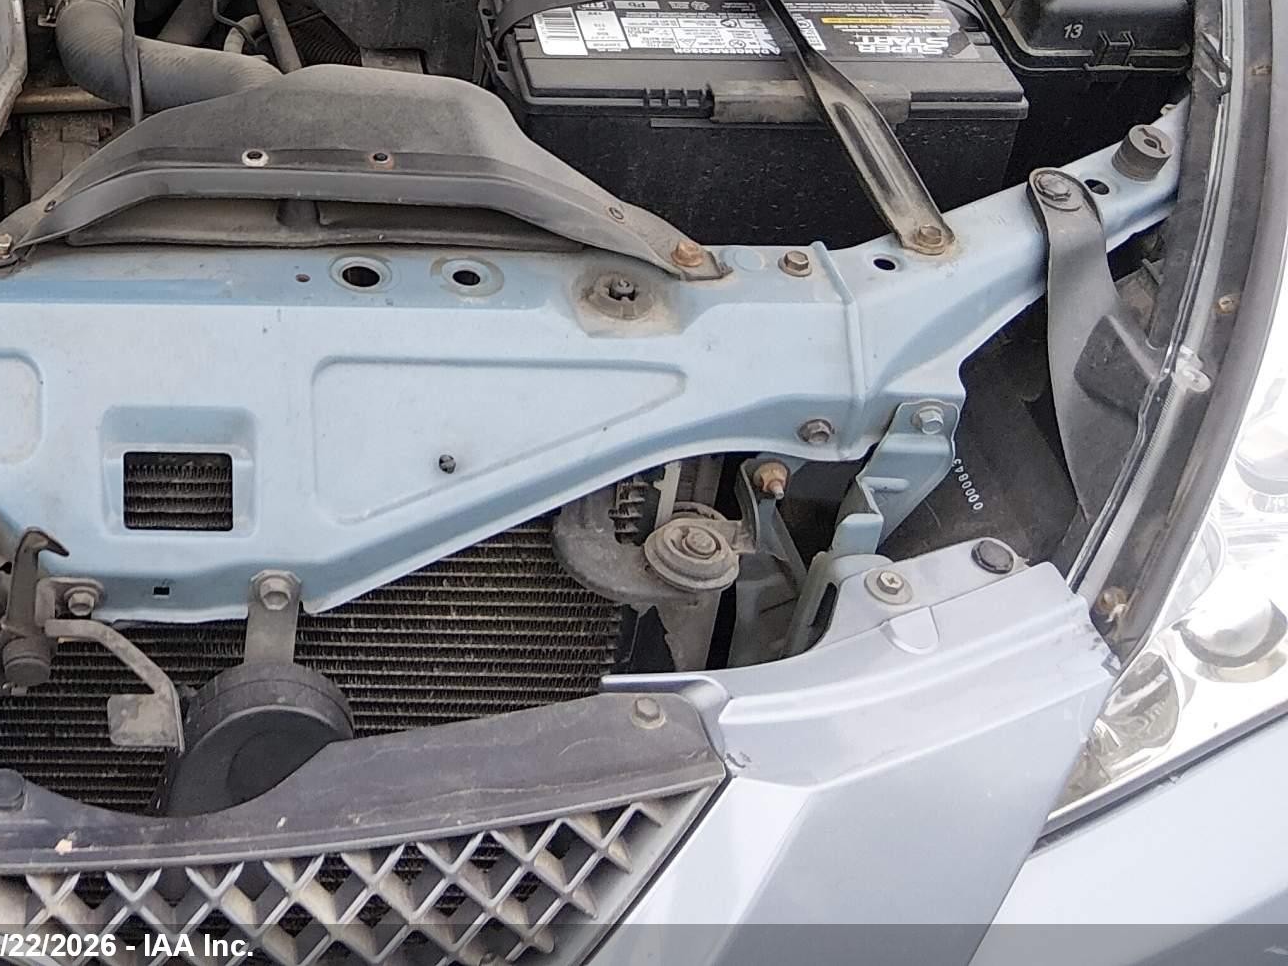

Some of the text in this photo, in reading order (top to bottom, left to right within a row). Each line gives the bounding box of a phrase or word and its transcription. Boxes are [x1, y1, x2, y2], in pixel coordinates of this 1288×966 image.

[1064, 23, 1084, 39] 13
[853, 35, 949, 46] START
[856, 44, 943, 55] SUPER
